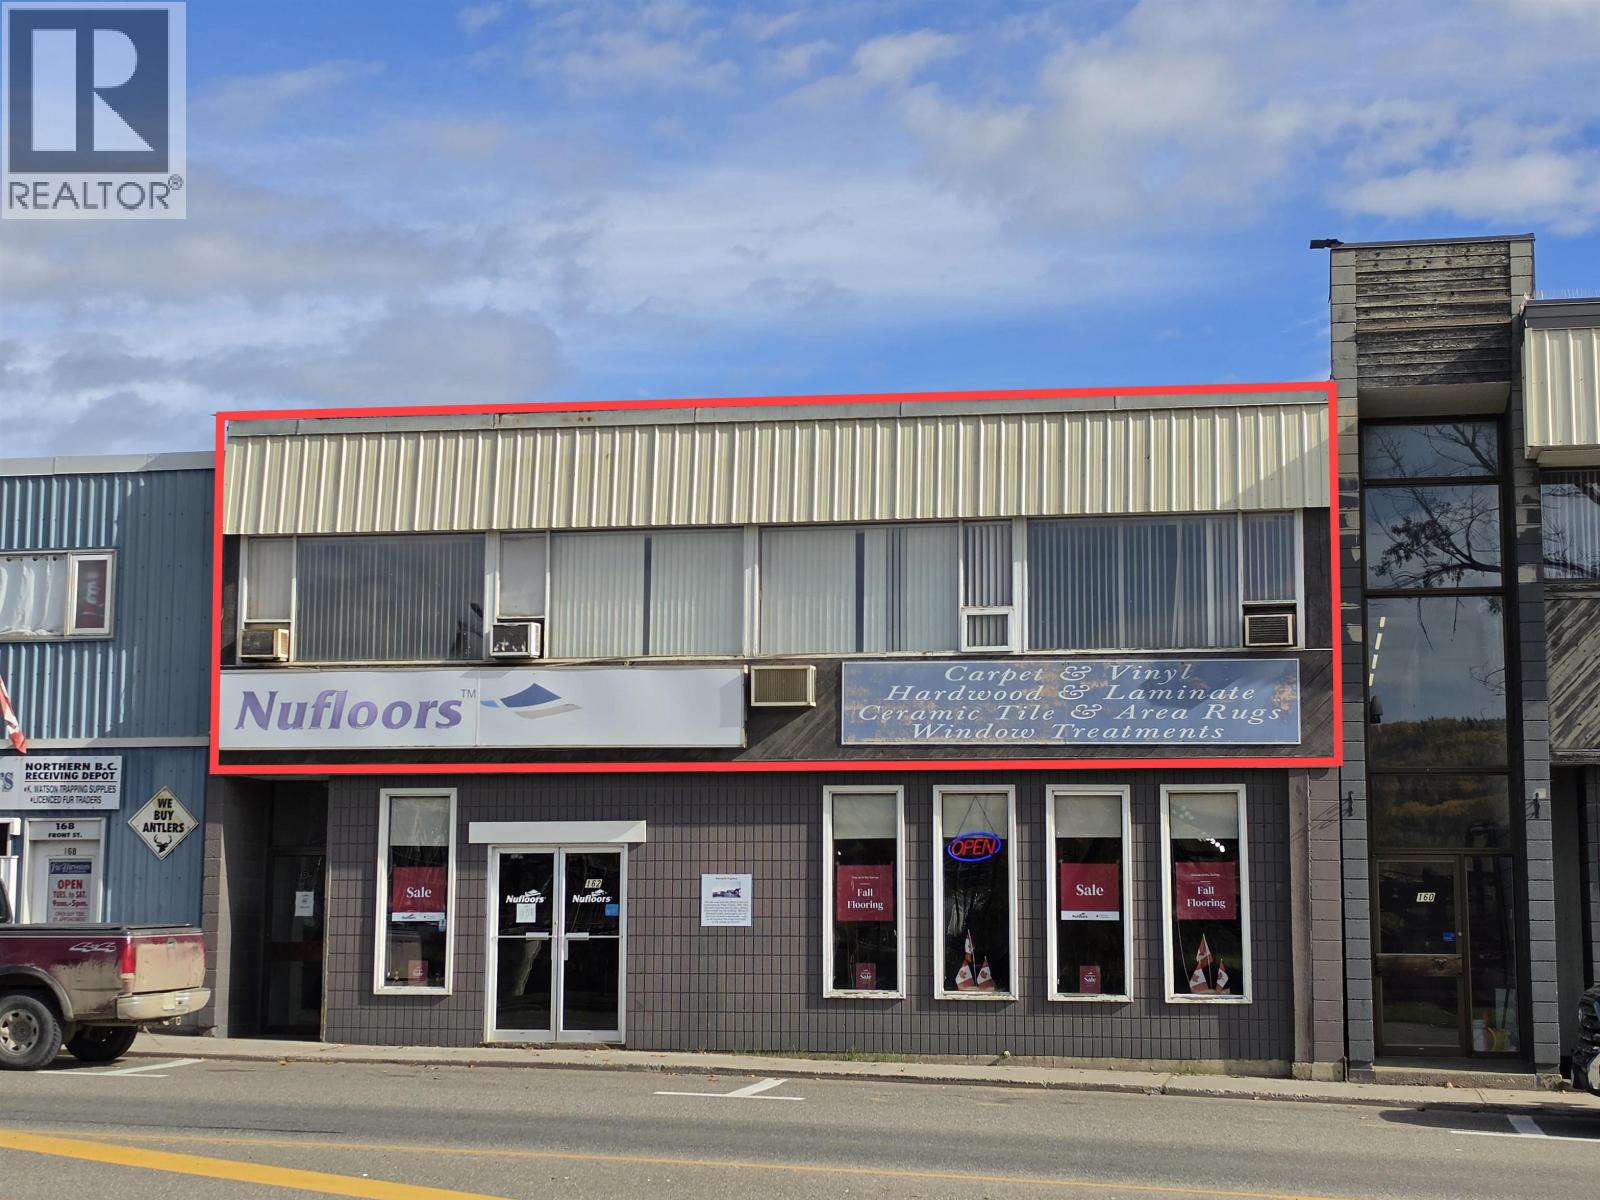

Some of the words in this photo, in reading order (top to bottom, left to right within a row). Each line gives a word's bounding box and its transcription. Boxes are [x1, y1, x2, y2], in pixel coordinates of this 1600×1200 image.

[944, 665, 1043, 686] Carpet
[1059, 665, 1091, 681] &
[1109, 663, 1193, 683] Vinyl
[885, 684, 1043, 702] Hardwood
[1057, 683, 1090, 700] &
[1102, 681, 1256, 701] Laminate
[234, 689, 462, 731] Nufloors
[858, 703, 979, 722] Ceramic
[998, 703, 1055, 722] Tile
[1070, 702, 1102, 720] &
[1117, 702, 1190, 721] Area
[1204, 701, 1281, 726] Rugs
[911, 722, 1035, 740] Window
[1051, 722, 1225, 740] Treatments
[25, 763, 91, 771] NORTHERN
[94, 763, 118, 771] B.C.
[25, 772, 79, 780] RECEIVING
[81, 772, 116, 780] DEPOT
[34, 785, 59, 793] WATSON
[59, 785, 88, 793] TRAPPING
[89, 785, 117, 793] SUPPLIES
[62, 796, 75, 804] FUR
[76, 796, 102, 804] TRADERS
[157, 798, 173, 808] WE
[153, 810, 175, 821] BUY
[142, 822, 185, 833] ANTLERS
[64, 847, 77, 856] 168
[951, 839, 996, 855] OPEN
[57, 879, 83, 889] OPEN
[586, 880, 601, 888] 162
[406, 886, 432, 899] Sale
[857, 888, 873, 897] Fall
[1075, 884, 1104, 896] Sale
[1197, 886, 1215, 895] Fall
[505, 894, 545, 904] Nufloors
[572, 894, 611, 904] Nufloors
[1187, 898, 1226, 909] Flooring
[847, 900, 884, 910] Flooring
